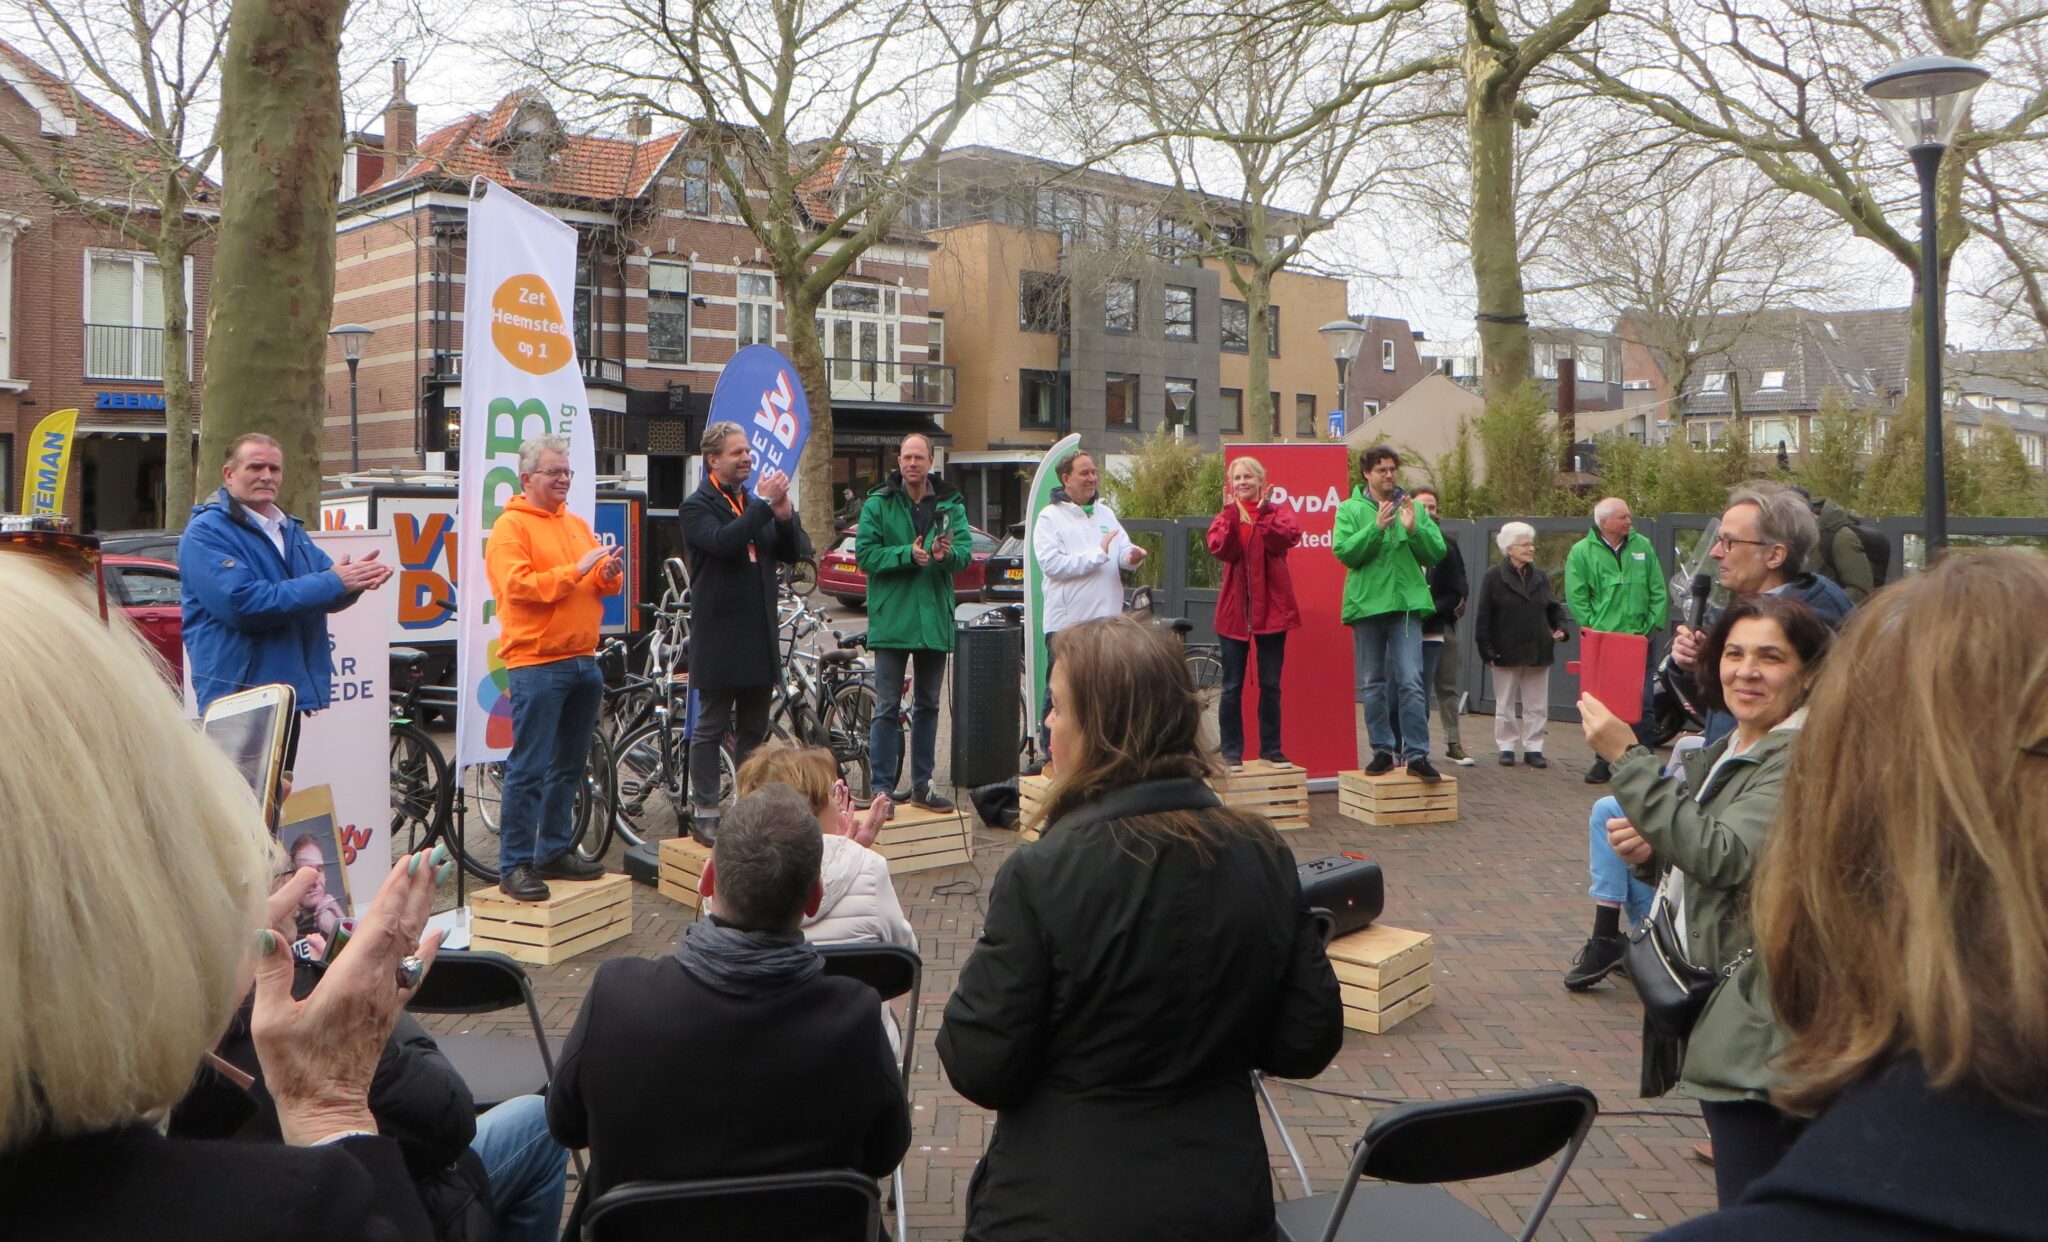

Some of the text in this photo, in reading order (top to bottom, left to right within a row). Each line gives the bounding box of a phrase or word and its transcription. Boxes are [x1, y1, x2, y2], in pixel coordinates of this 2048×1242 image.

[519, 287, 546, 306] Zet
[518, 341, 548, 358] op 1
[753, 369, 799, 450] VVD
[35, 432, 65, 514] EMAN
